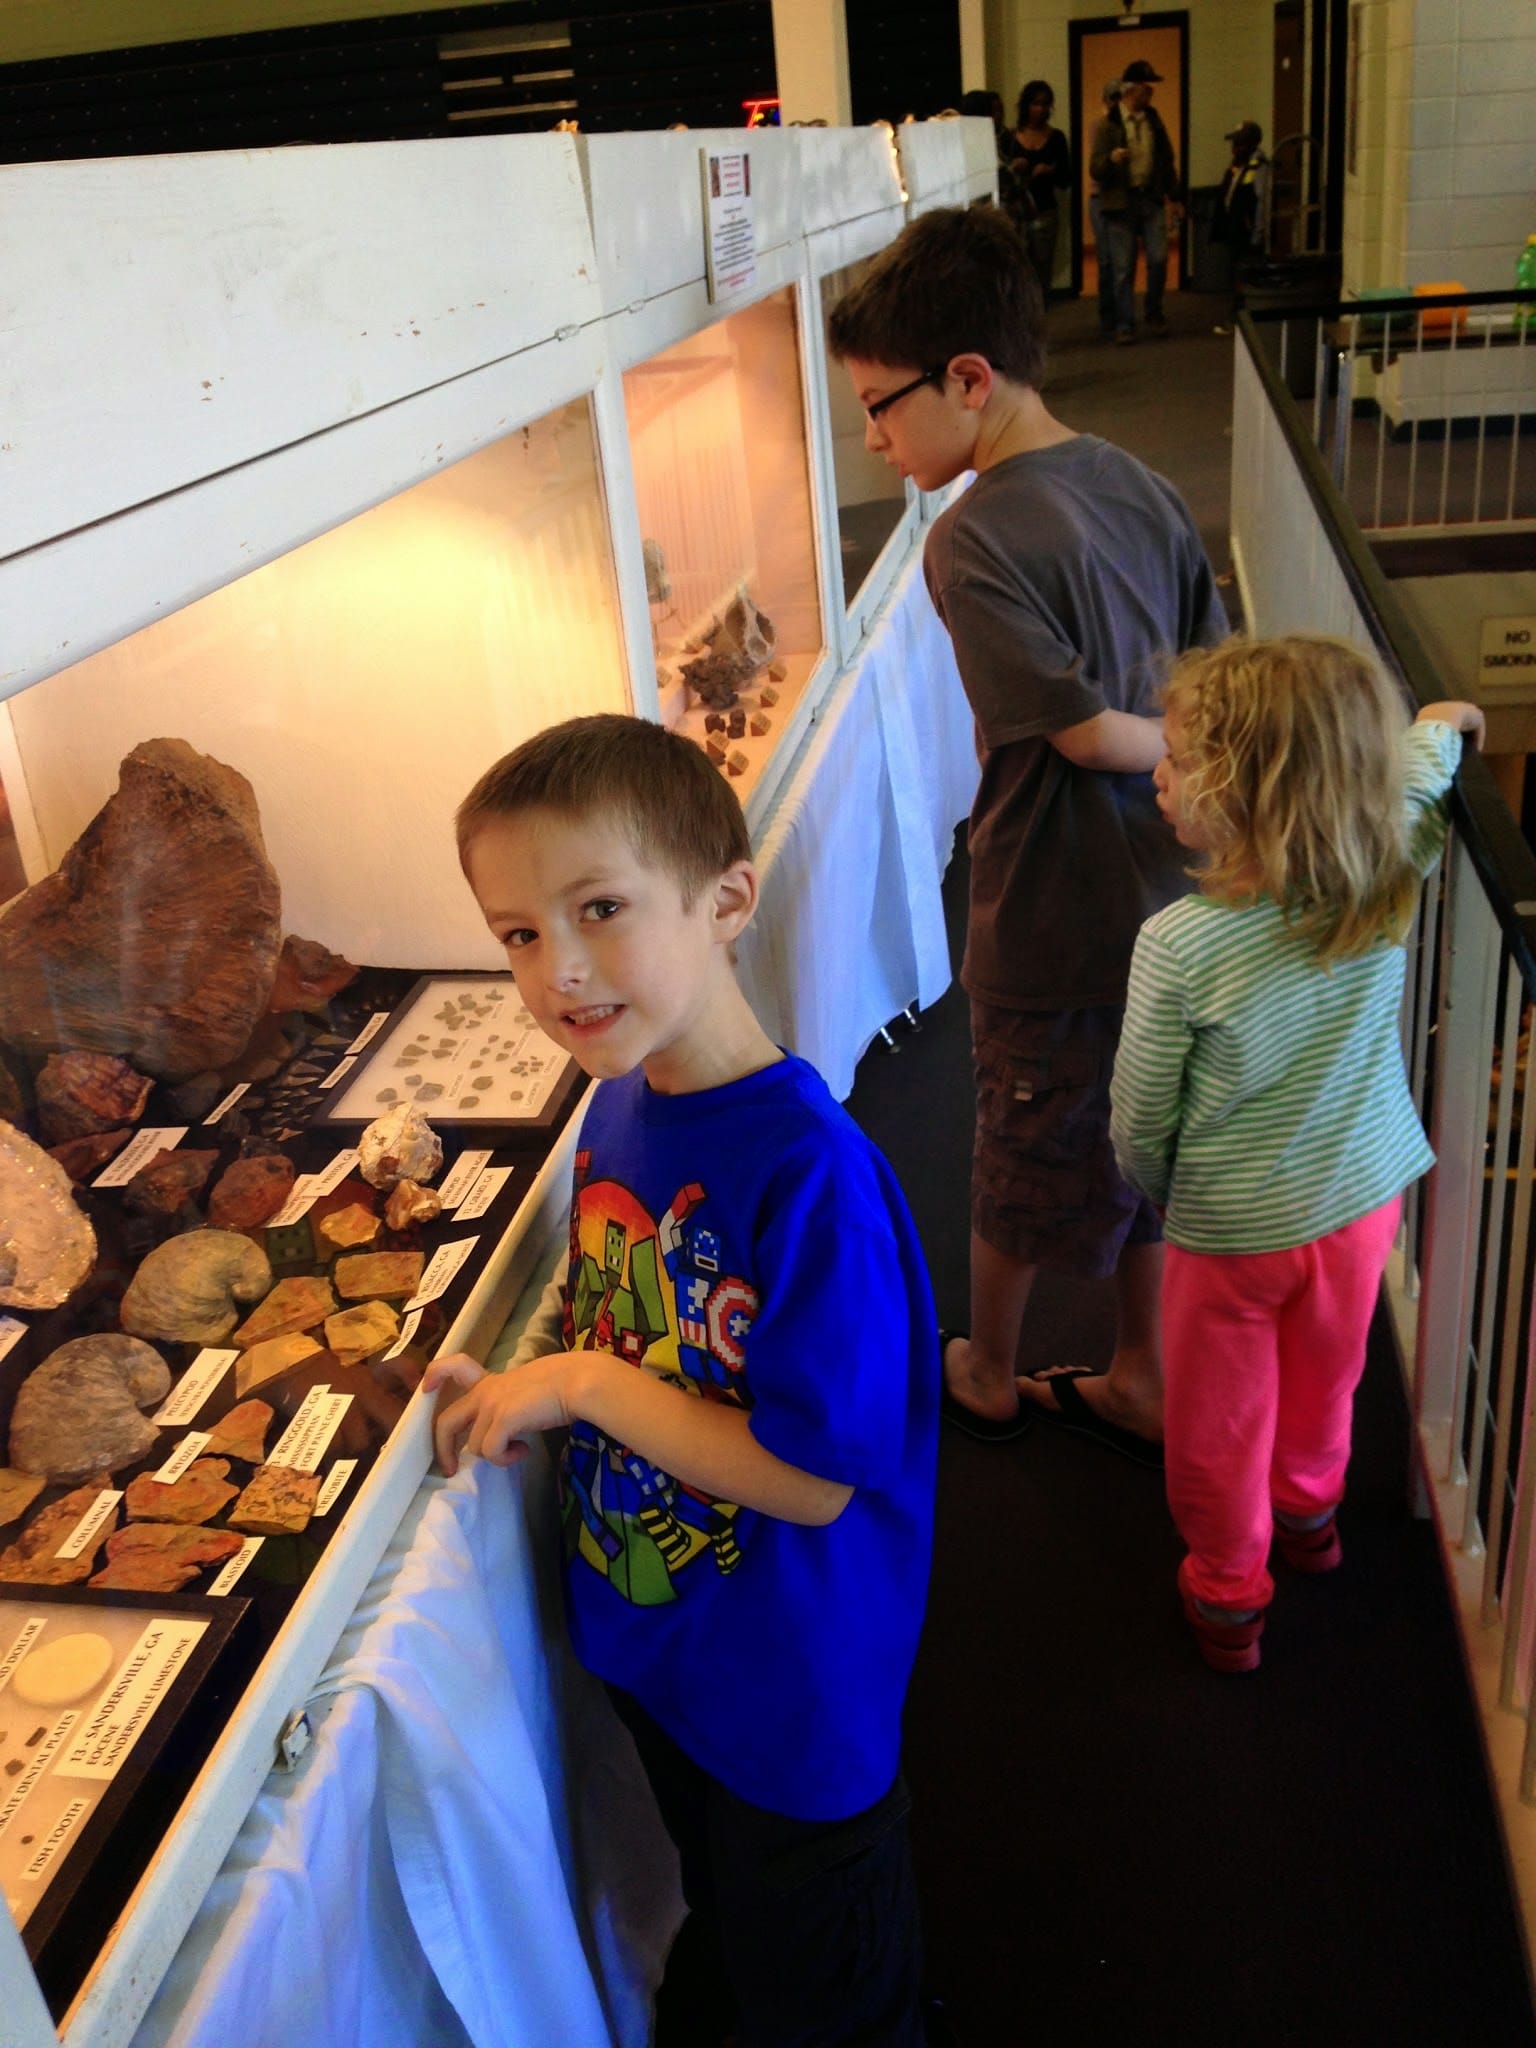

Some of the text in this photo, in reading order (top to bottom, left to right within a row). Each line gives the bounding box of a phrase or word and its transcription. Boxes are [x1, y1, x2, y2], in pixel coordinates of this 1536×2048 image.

[1505, 630, 1531, 646] NO
[166, 1380, 199, 1416] PELECYPOD
[309, 1391, 322, 1405] GA
[168, 1441, 202, 1474] BRYOZOA
[300, 1449, 316, 1467] FORT
[312, 1422, 331, 1447] PAYNE
[318, 1469, 347, 1509] TRILOBITE
[72, 1501, 112, 1548] COLUMNAL
[219, 1549, 251, 1588] BLASTOID
[7, 1624, 39, 1665] DOLLAR
[70, 1749, 87, 1762] 13
[86, 1652, 152, 1739] SANDERSVILLE,
[146, 1631, 164, 1649] GA
[103, 1637, 191, 1767] SANDERSVILLE LIMESTONE
[17, 1752, 50, 1794] DENTAL
[45, 1713, 75, 1749] PLATES
[86, 1724, 121, 1765] EOCENE
[28, 1803, 84, 1873] FISH TOOTH
